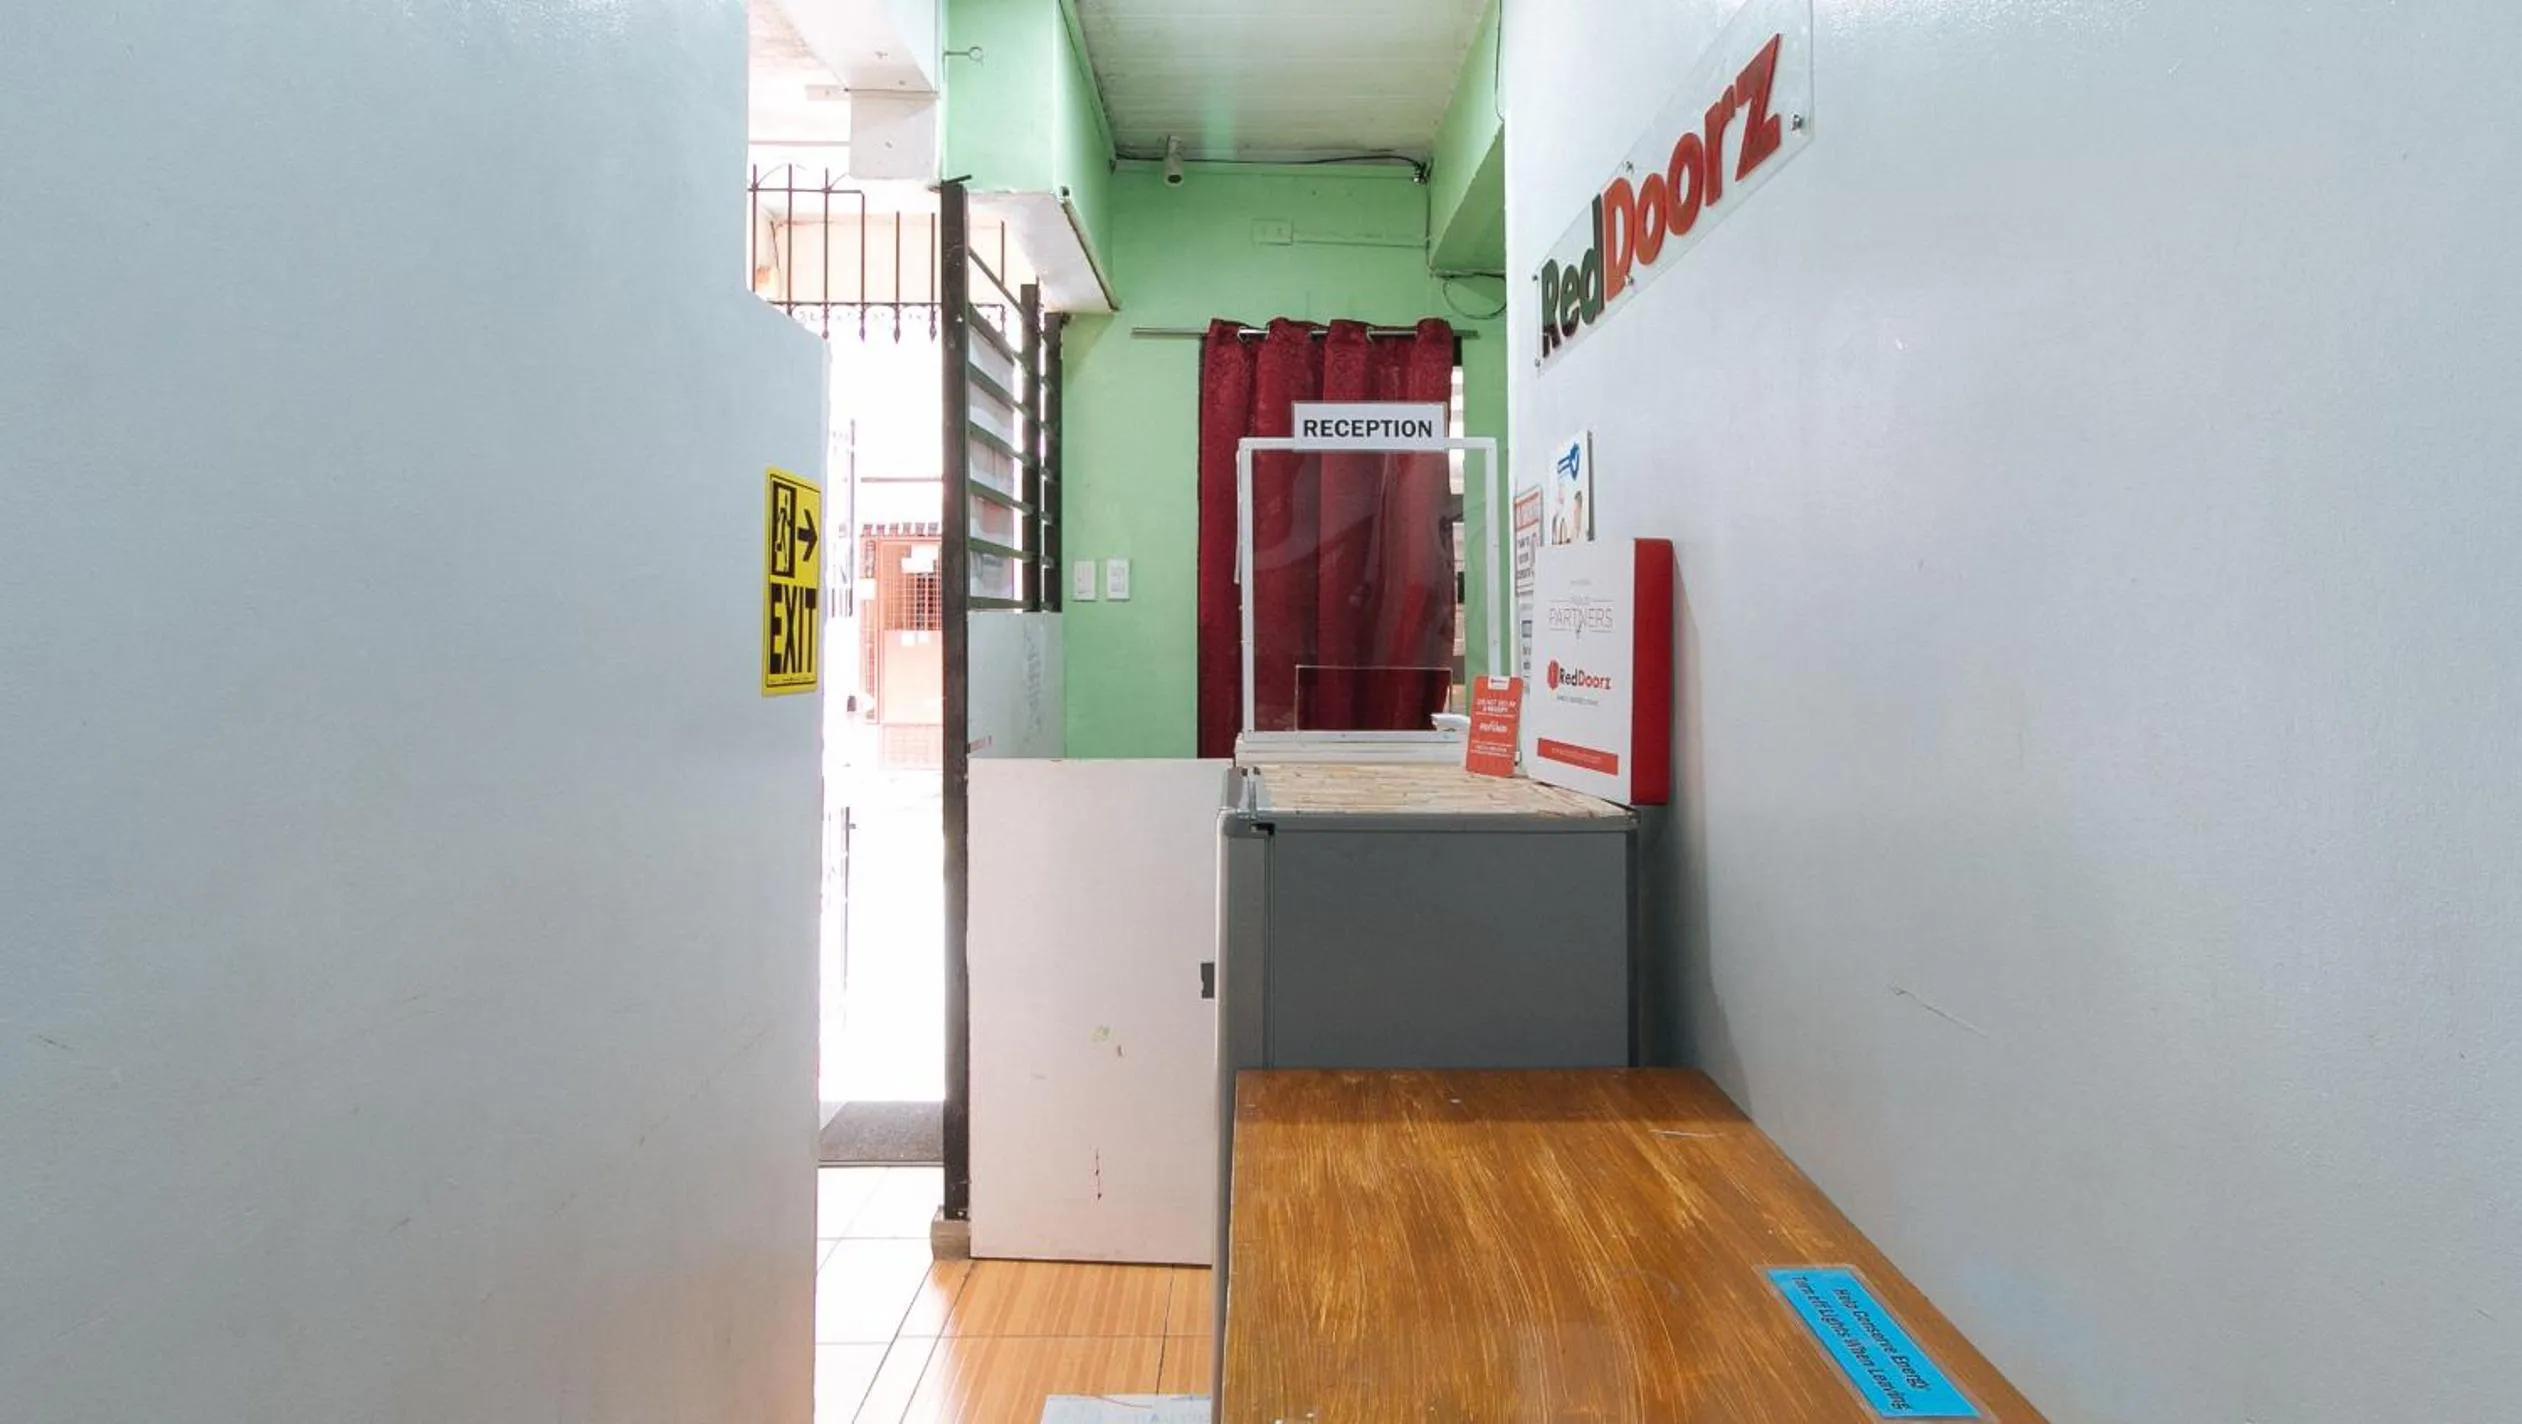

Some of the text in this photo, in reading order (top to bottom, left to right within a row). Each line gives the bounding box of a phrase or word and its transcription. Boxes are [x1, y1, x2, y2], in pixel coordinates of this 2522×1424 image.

[1541, 33, 1781, 358] RedDoorz
[1303, 419, 1433, 438] RECEPTION
[769, 583, 817, 674] EXIT
[1549, 607, 1613, 629] PARTNERS
[1559, 668, 1611, 690] RedDoorz
[1819, 1309, 1851, 1337] Lights
[1844, 1339, 1874, 1366] When
[1867, 1368, 1911, 1410] Leaving
[1832, 1289, 1930, 1390] Help Conserve Energy
